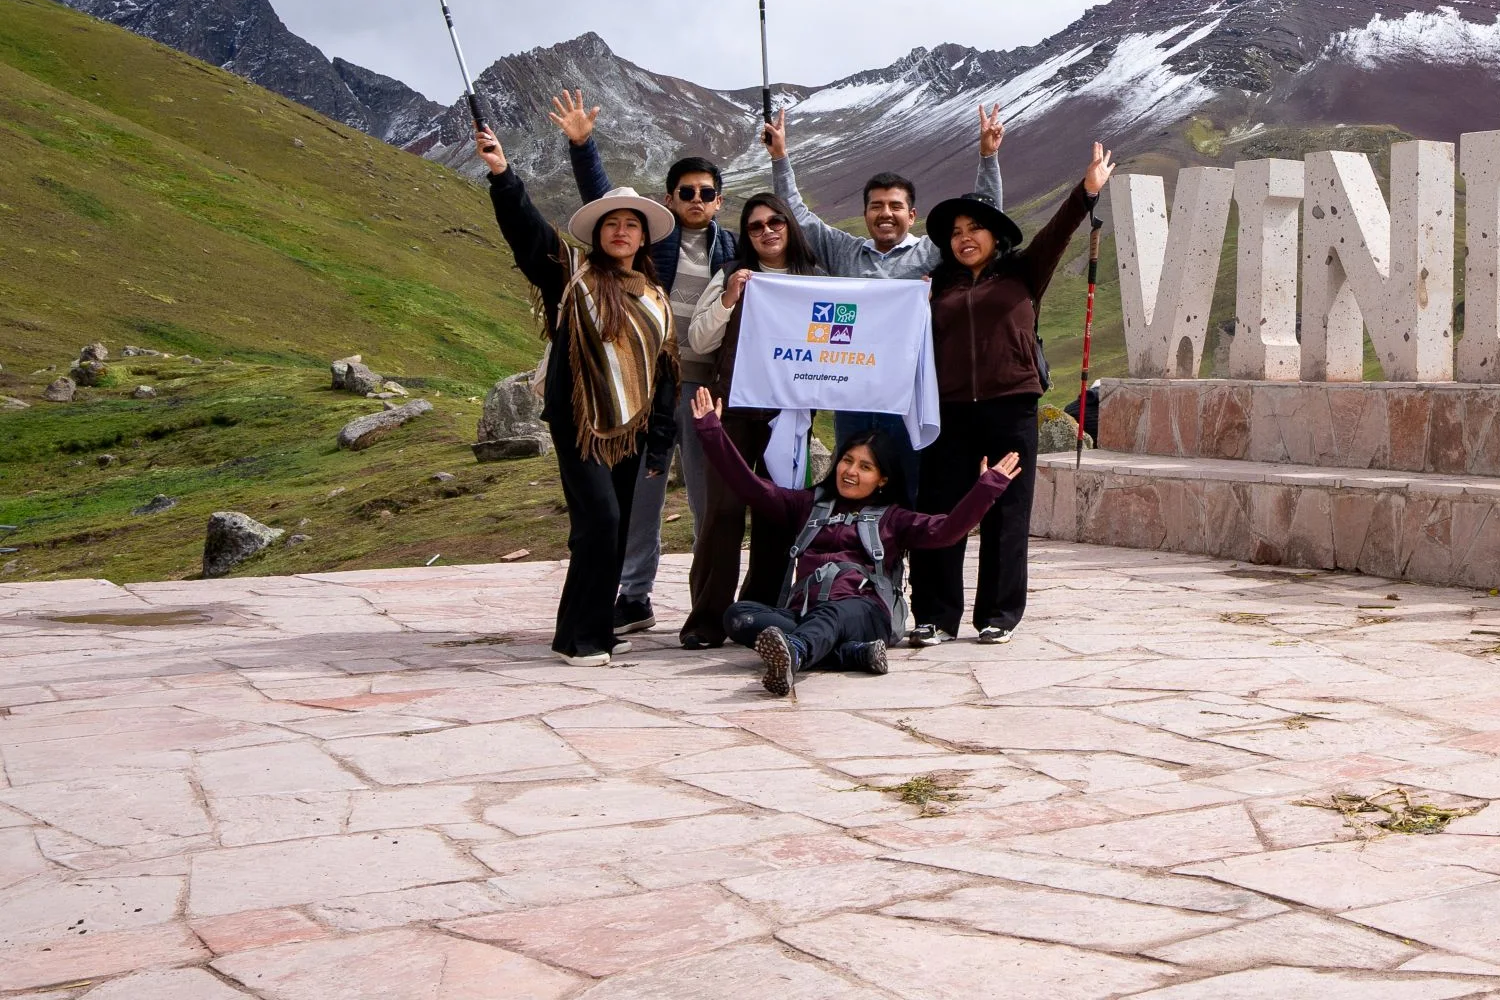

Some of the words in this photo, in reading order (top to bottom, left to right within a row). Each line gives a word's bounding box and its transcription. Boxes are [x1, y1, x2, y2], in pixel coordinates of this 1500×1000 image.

[773, 347, 813, 362] PATA
[819, 349, 876, 366] RUTERA
[793, 372, 849, 383] patarutera.pe
